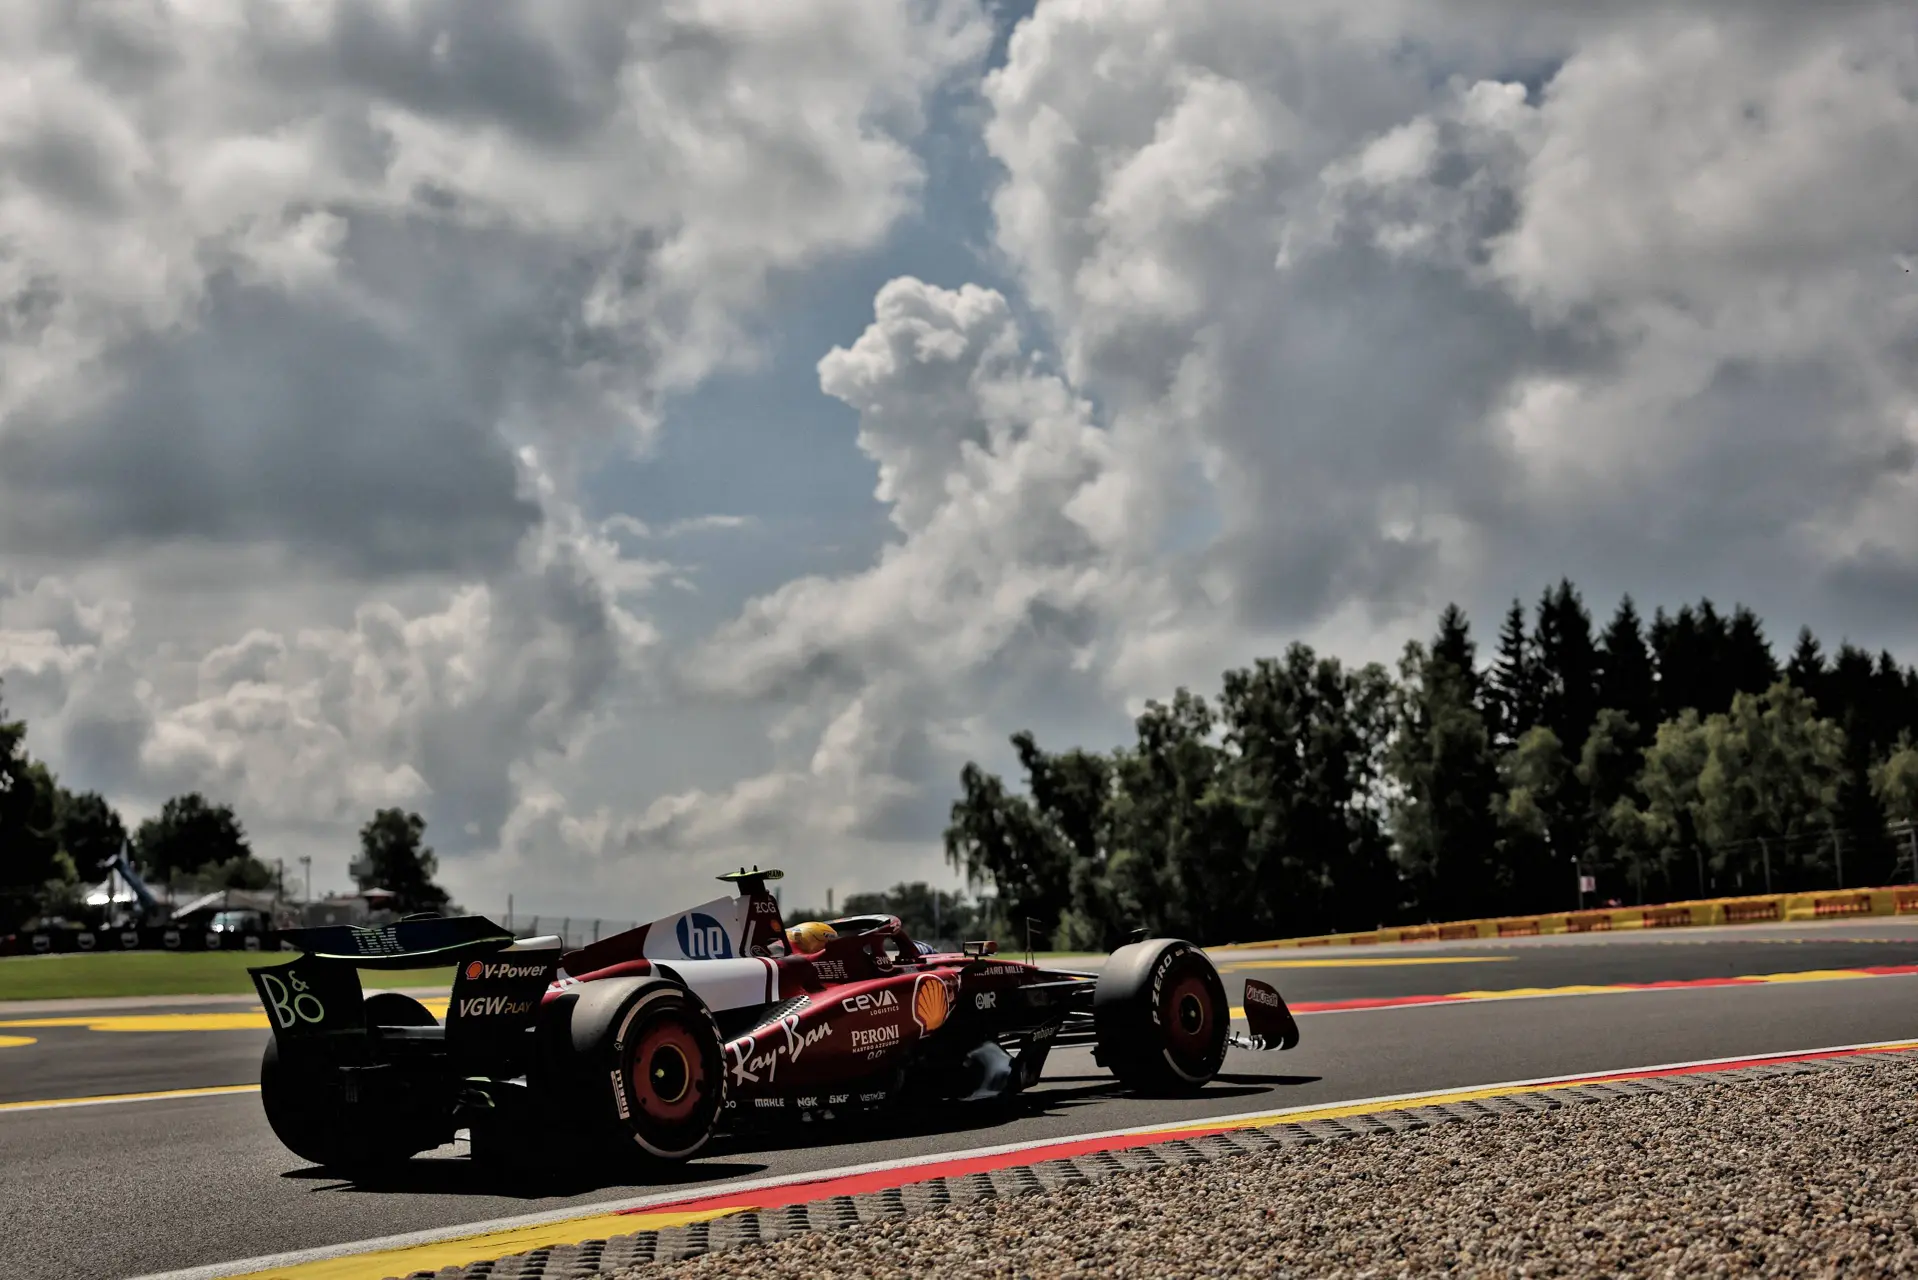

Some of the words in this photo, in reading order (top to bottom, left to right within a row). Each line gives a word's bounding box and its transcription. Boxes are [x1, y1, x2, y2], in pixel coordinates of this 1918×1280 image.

[351, 927, 406, 954] IBM
[685, 913, 724, 959] hp
[484, 963, 548, 979] V-Power
[812, 959, 849, 979] IBM
[1152, 954, 1173, 1007] ZERO
[459, 995, 508, 1018] VGW
[504, 1001, 534, 1015] PLAY
[870, 1005, 900, 1016] LOGISTICS
[851, 1024, 900, 1047] PERONI
[754, 1097, 785, 1108] MAHLE
[797, 1096, 819, 1107] NGK
[829, 1093, 850, 1104] SKF
